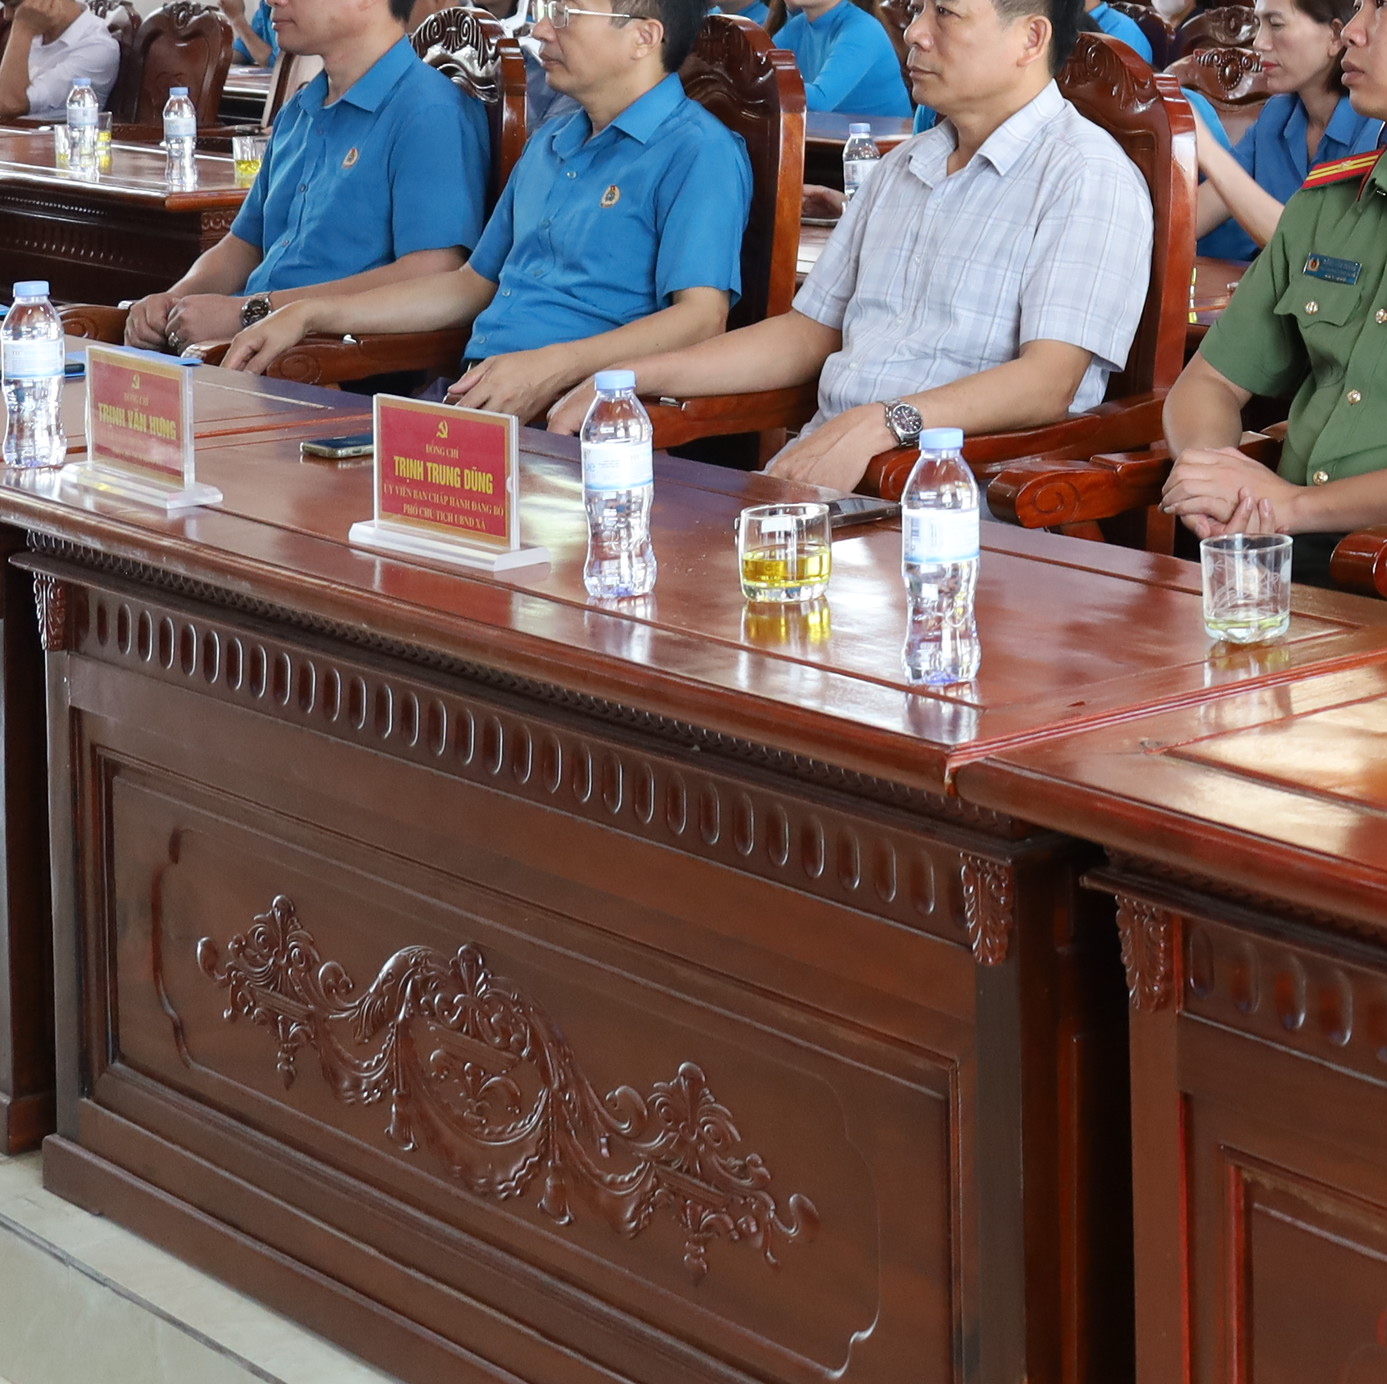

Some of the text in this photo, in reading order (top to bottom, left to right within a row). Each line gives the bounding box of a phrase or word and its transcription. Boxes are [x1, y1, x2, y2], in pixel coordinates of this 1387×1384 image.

[393, 455, 494, 495] TRỊNH TRUNG DŨNG
